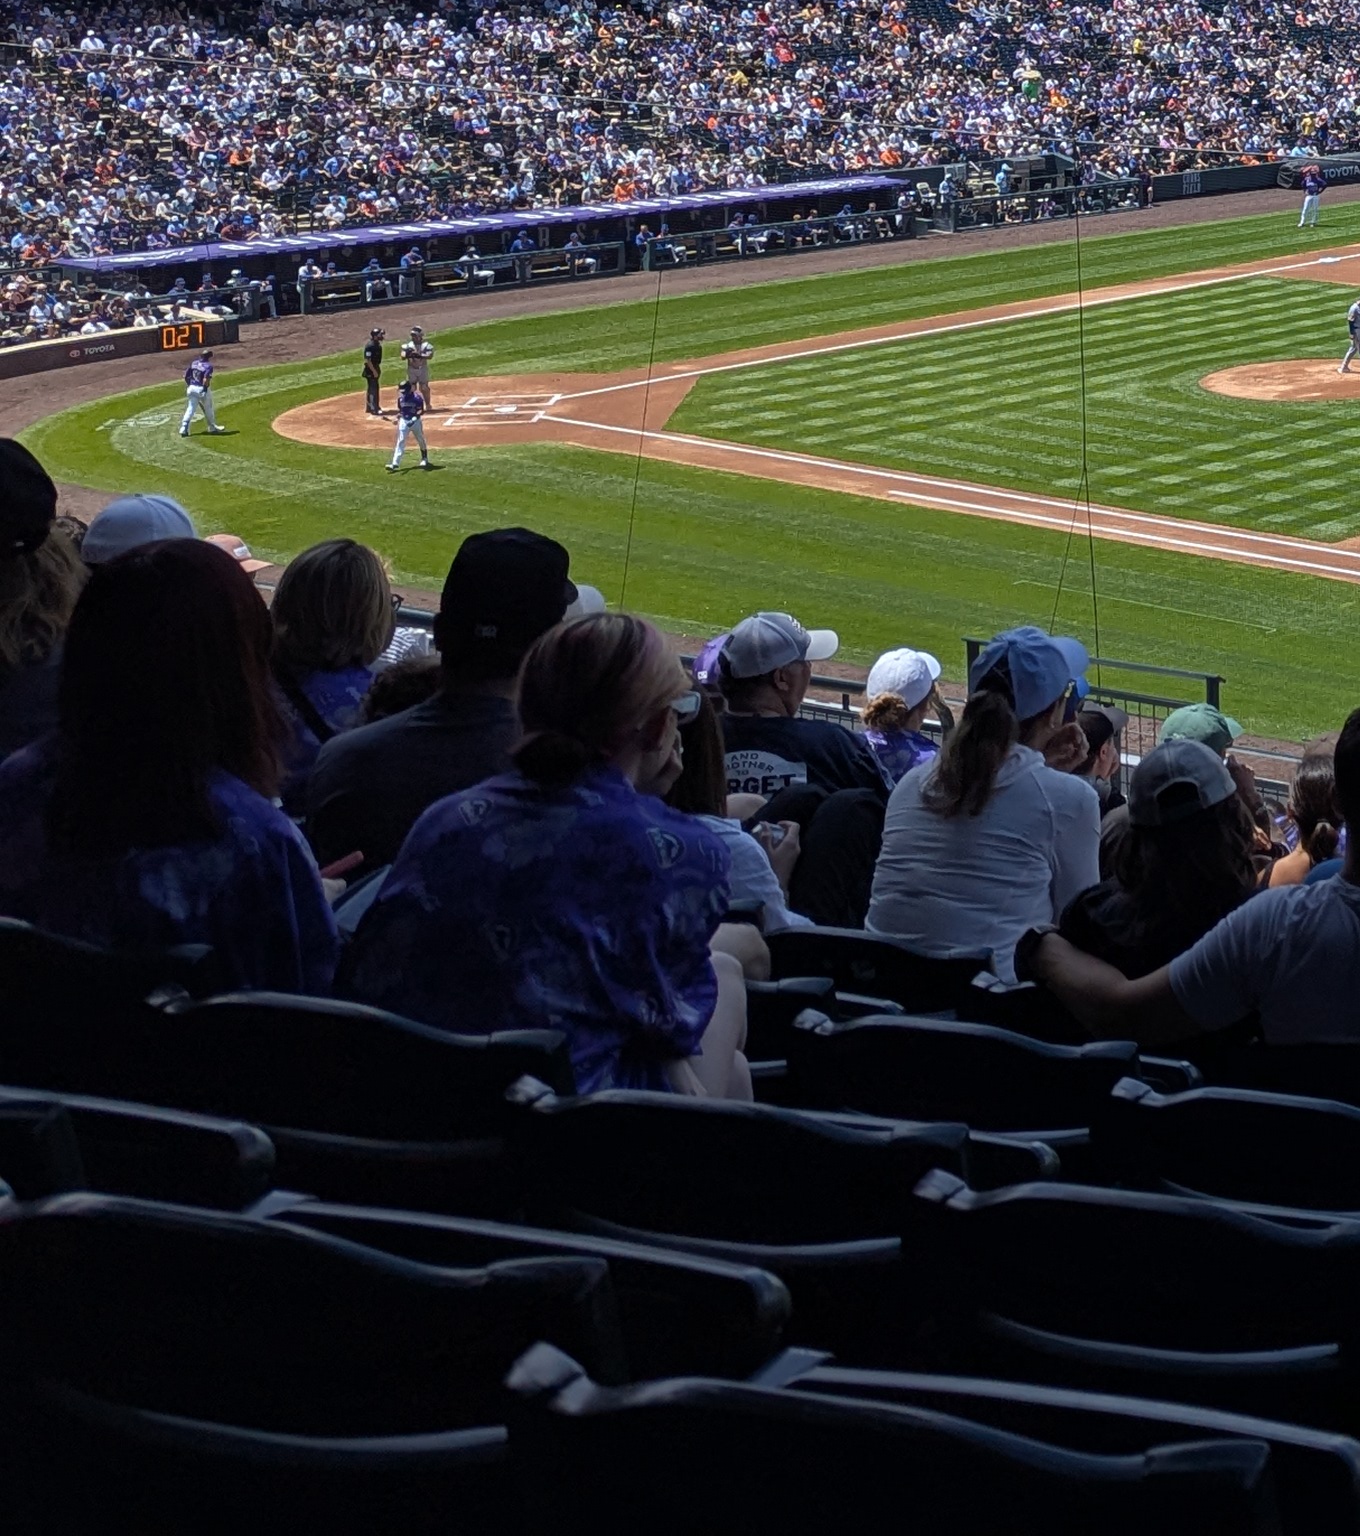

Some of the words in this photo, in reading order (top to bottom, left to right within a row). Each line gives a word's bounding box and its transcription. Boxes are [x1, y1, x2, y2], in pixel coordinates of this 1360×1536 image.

[1323, 165, 1360, 179] TOYOTA
[162, 323, 203, 349] 0:27
[84, 344, 115, 355] TOYOTA
[731, 752, 759, 762] AND
[727, 774, 796, 794] RGET
